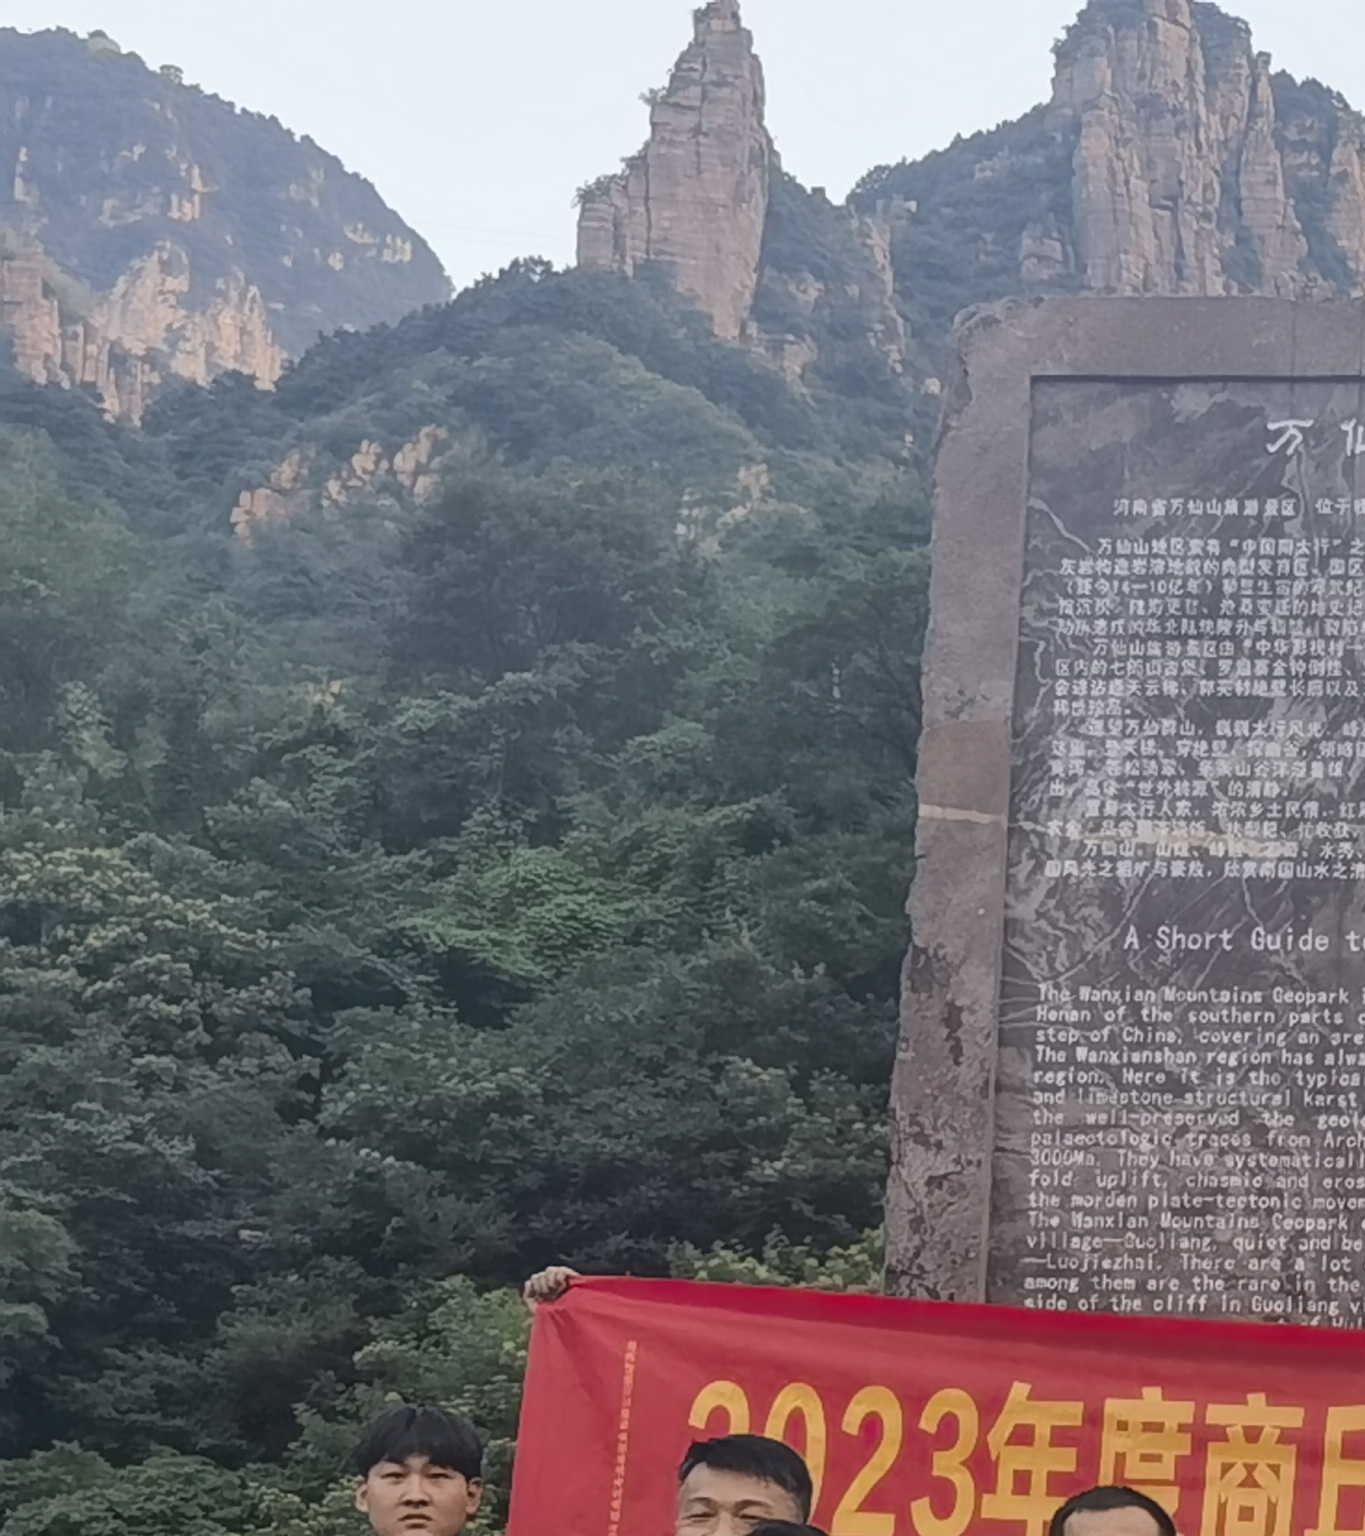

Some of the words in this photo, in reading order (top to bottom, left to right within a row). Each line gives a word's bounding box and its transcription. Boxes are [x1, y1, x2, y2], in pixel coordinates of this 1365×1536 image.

[1124, 926, 1138, 951] A
[1156, 927, 1232, 952] Short
[1251, 928, 1328, 953] Guide
[1039, 986, 1069, 1002] The
[1078, 987, 1155, 1003] Wanxian
[1164, 988, 1263, 1004] Mountains
[1272, 989, 1349, 1009] Geopark
[1037, 1007, 1090, 1023] Henan
[1104, 1008, 1125, 1023] of
[1141, 1008, 1172, 1024] the
[1188, 1009, 1275, 1025] southern
[1289, 1011, 1345, 1030] parts
[1036, 1029, 1079, 1047] step
[1089, 1028, 1110, 1044] of
[1200, 1029, 1286, 1050] covering
[1298, 1034, 1320, 1046] an
[1036, 1048, 1067, 1064] The
[1207, 1050, 1272, 1070] region
[1282, 1051, 1312, 1067] has
[1122, 1070, 1165, 1086] Here
[1181, 1070, 1199, 1086] it
[1216, 1071, 1234, 1086] is
[1250, 1071, 1282, 1087] the
[1033, 1089, 1064, 1105] and
[1304, 1092, 1357, 1108] karst
[1030, 1171, 1073, 1187] fold
[1277, 1174, 1309, 1190] and
[1029, 1192, 1059, 1208] the
[1028, 1212, 1060, 1228] The
[1071, 1213, 1149, 1229] Wanxian
[1161, 1214, 1259, 1230] Mountains
[1272, 1215, 1348, 1235] Geopark
[1024, 1278, 1079, 1294] among
[1093, 1275, 1135, 1291] them
[1147, 1279, 1180, 1291] are
[1193, 1276, 1224, 1292] the
[1237, 1280, 1280, 1292] rare
[1295, 1277, 1316, 1293] in
[1329, 1277, 1359, 1293] the
